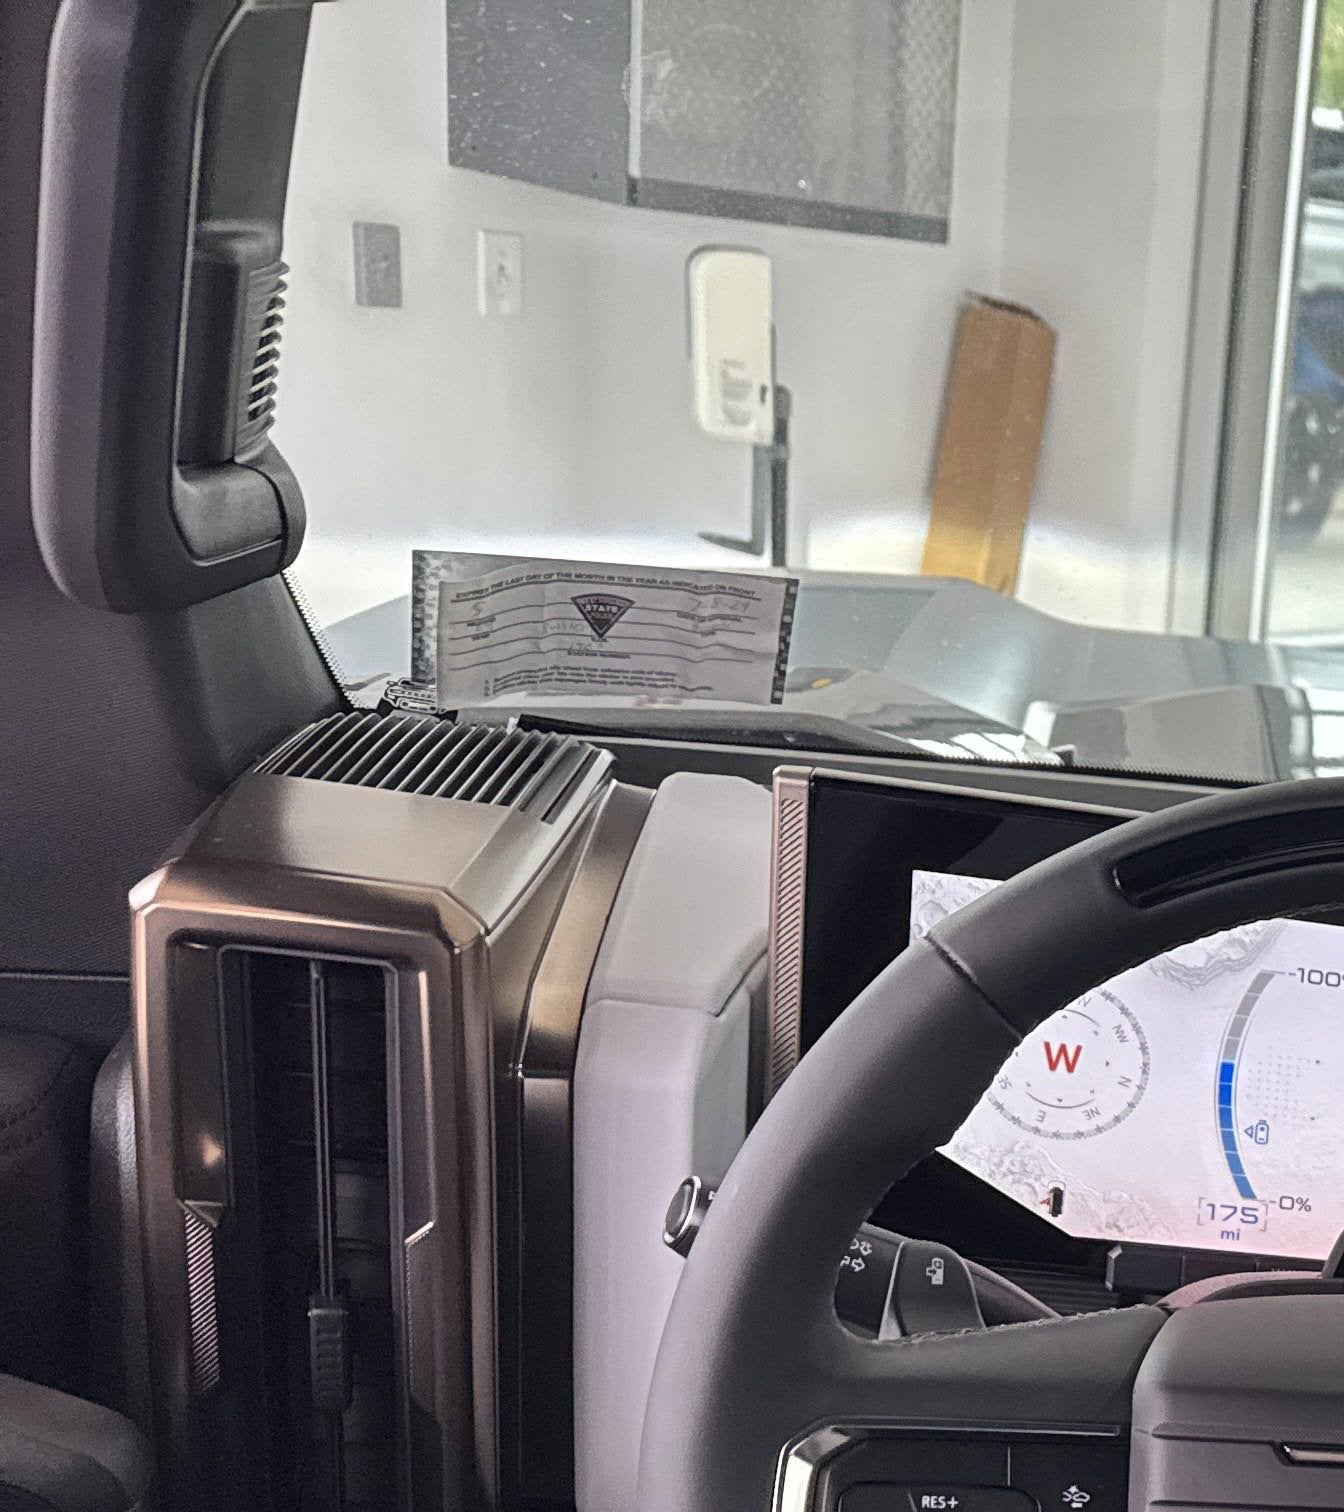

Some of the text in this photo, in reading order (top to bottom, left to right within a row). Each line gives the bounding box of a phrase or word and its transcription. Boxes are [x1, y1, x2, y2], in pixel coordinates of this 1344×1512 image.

[1111, 1023, 1130, 1045] NW
[1043, 1040, 1083, 1073] W
[1117, 1075, 1133, 1089] N
[1082, 1105, 1101, 1121] NE
[1278, 1195, 1313, 1213] 0%
[1206, 1202, 1260, 1225] 175
[1220, 1228, 1241, 1242] mi
[921, 1494, 959, 1510] RES+
